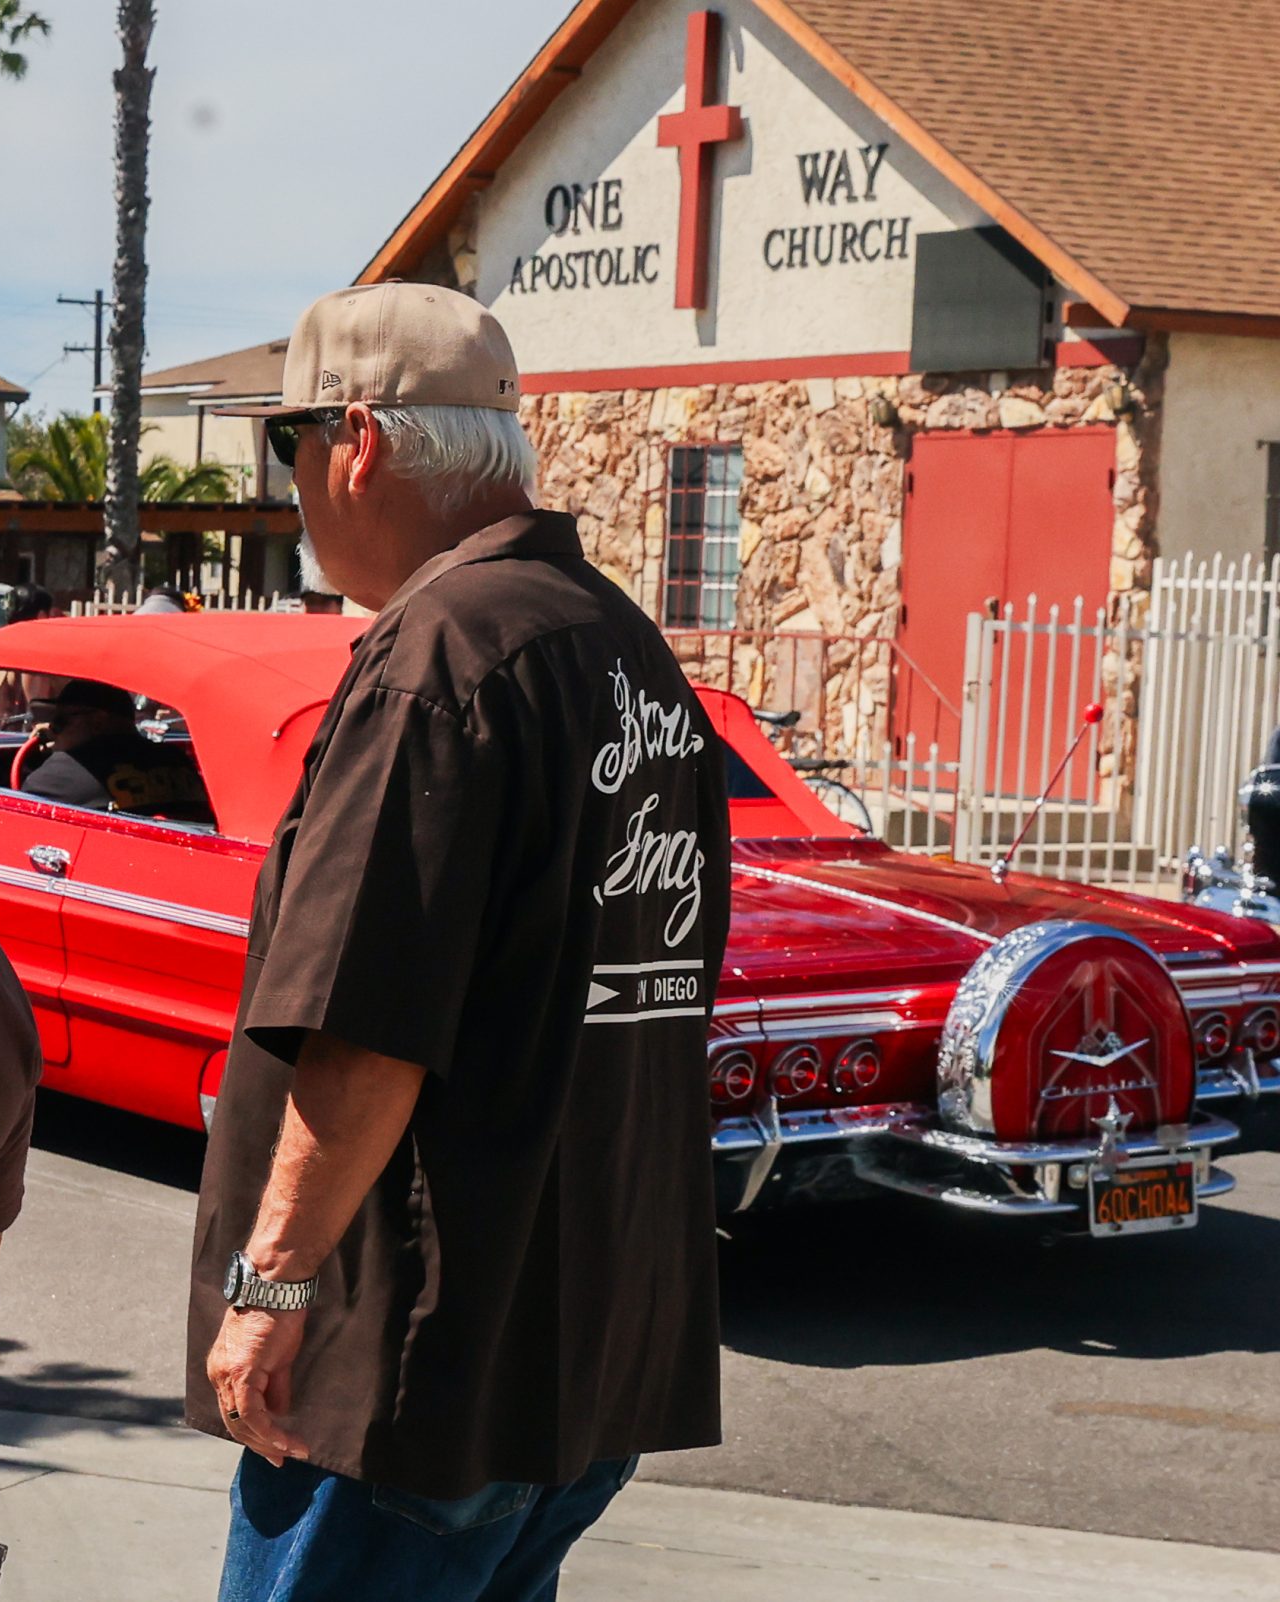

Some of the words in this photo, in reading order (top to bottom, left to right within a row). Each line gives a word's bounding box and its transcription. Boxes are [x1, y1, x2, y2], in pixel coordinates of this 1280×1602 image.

[544, 179, 624, 239] ONE
[795, 143, 890, 207] WAY
[509, 244, 660, 295] APOSTOLIC
[763, 217, 912, 270] CHURCH
[654, 976, 698, 1002] DIEGO
